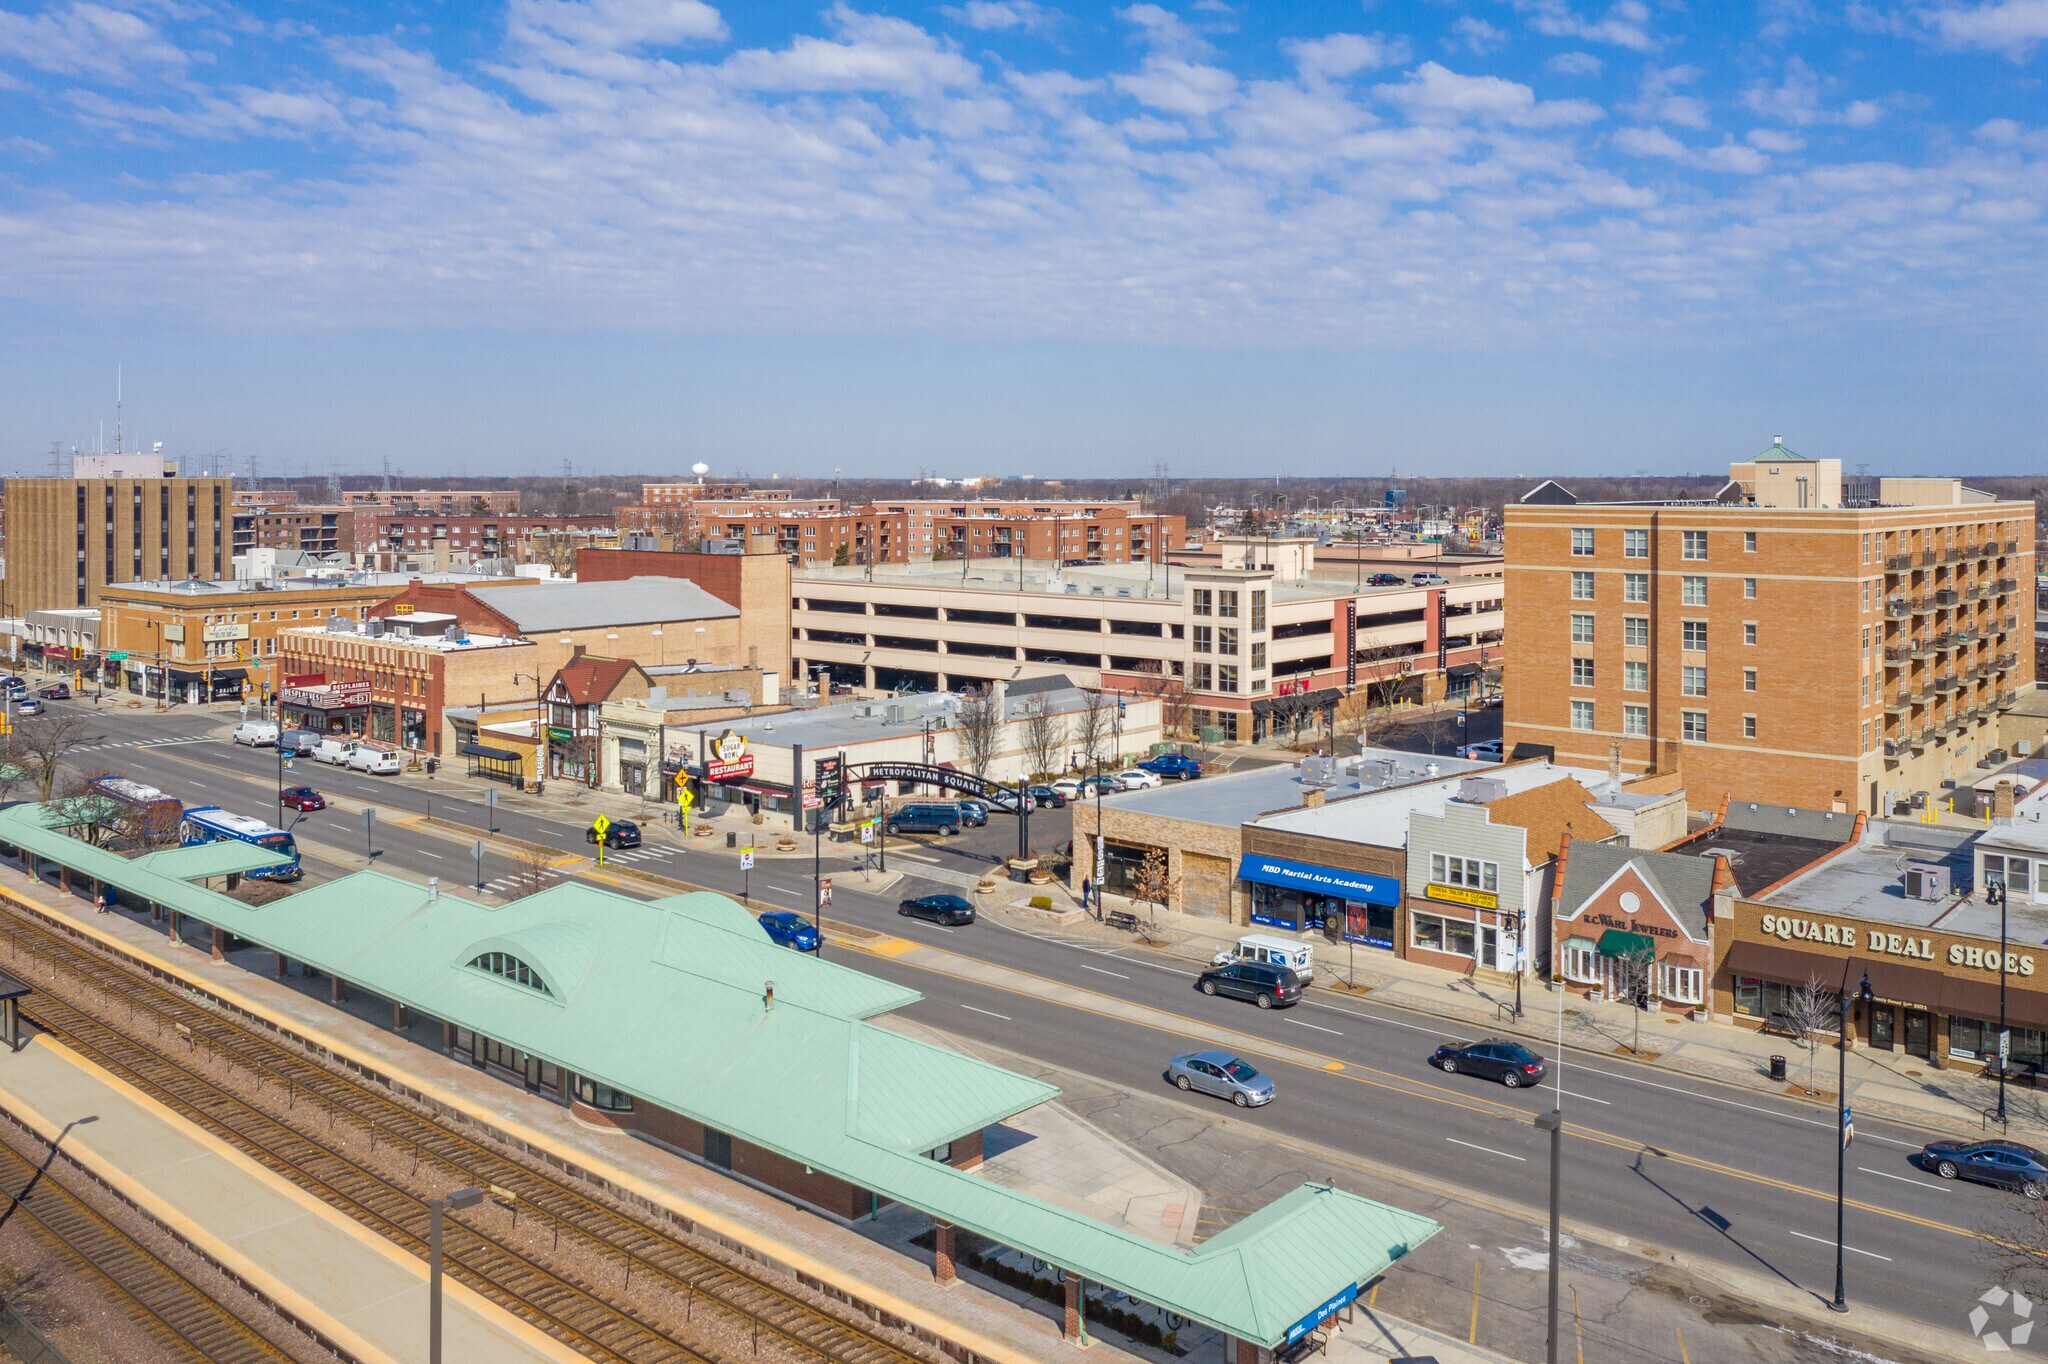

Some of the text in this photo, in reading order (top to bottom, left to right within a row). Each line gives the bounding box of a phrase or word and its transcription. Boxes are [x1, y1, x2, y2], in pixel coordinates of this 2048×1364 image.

[723, 743, 741, 752] SUGAR
[710, 762, 753, 775] RESTAURANT
[873, 768, 980, 793] METROPOLITAN SQUARE
[1261, 865, 1374, 892] MBD Martial Arts Academy
[1471, 893, 1494, 902] CLEANERS
[1762, 914, 2034, 975] SQUARE DEAL SHOES
[1318, 1295, 1346, 1320] Des Plaines
